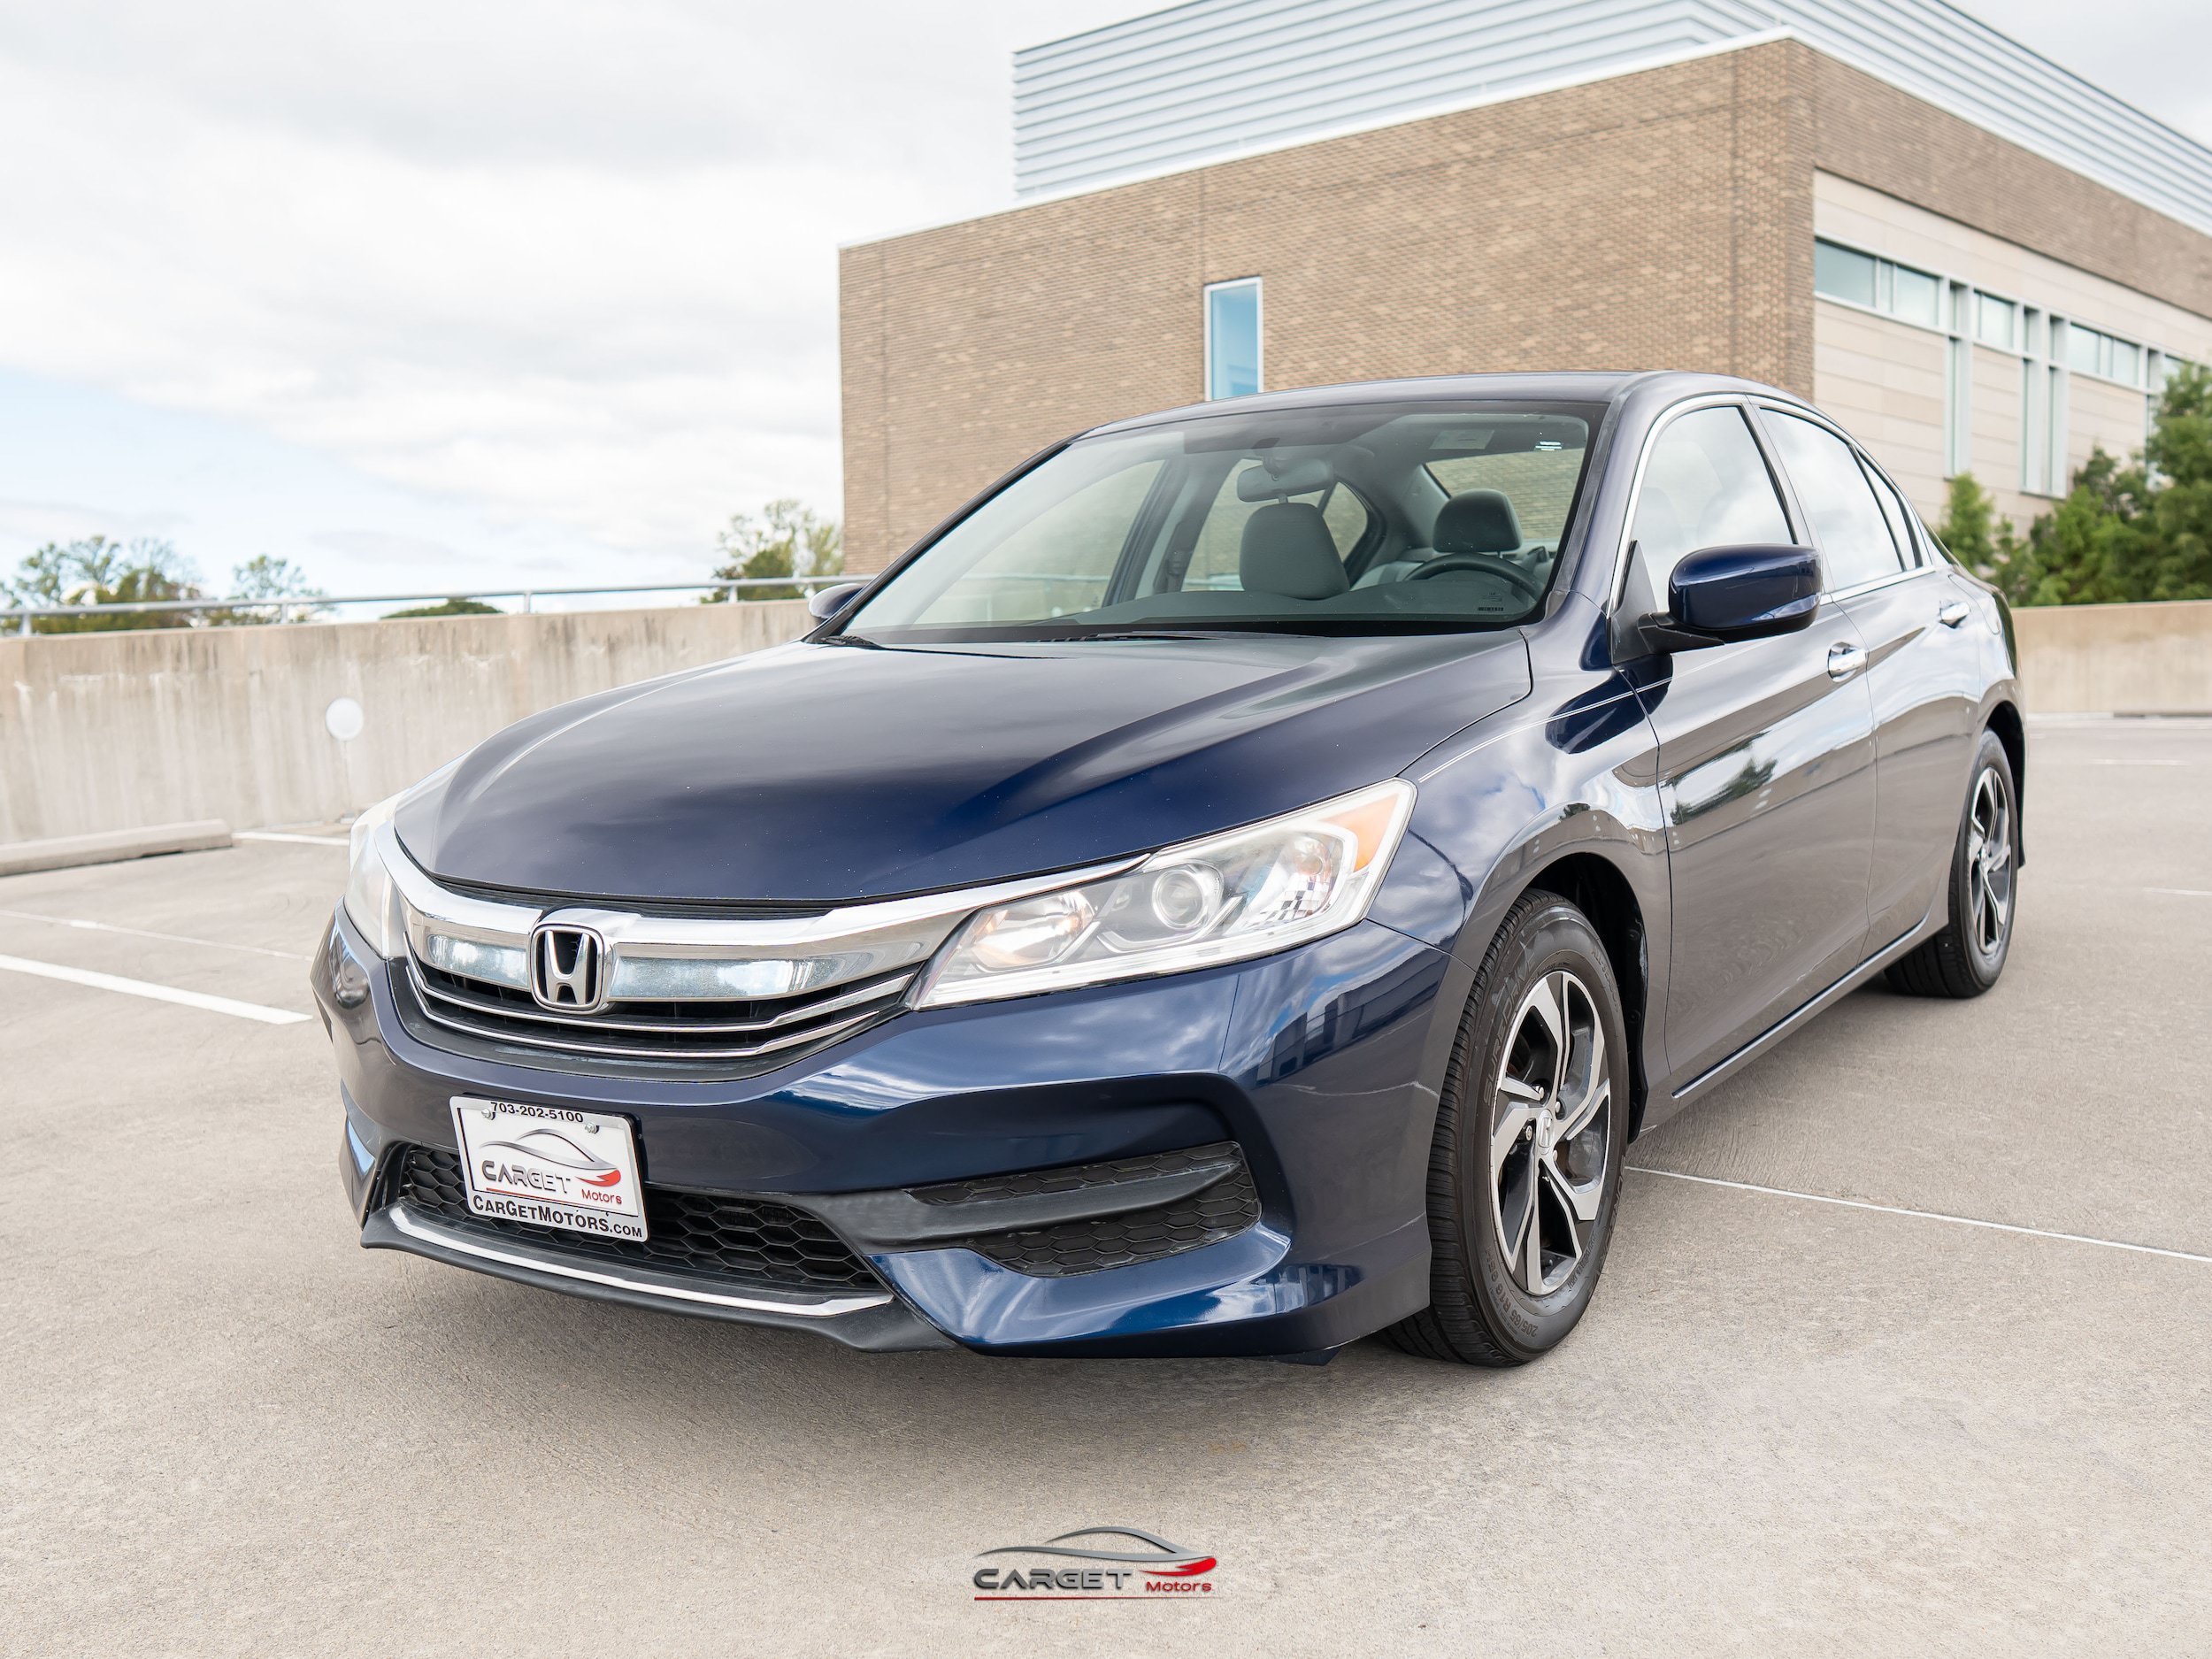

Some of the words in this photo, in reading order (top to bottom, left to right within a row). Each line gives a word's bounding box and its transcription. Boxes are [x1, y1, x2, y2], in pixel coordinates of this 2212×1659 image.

[490, 1102, 584, 1123] 703-202-5100
[481, 1160, 572, 1194] CARGET
[581, 1188, 622, 1204] Motors
[1509, 1310, 1540, 1338] 205/65
